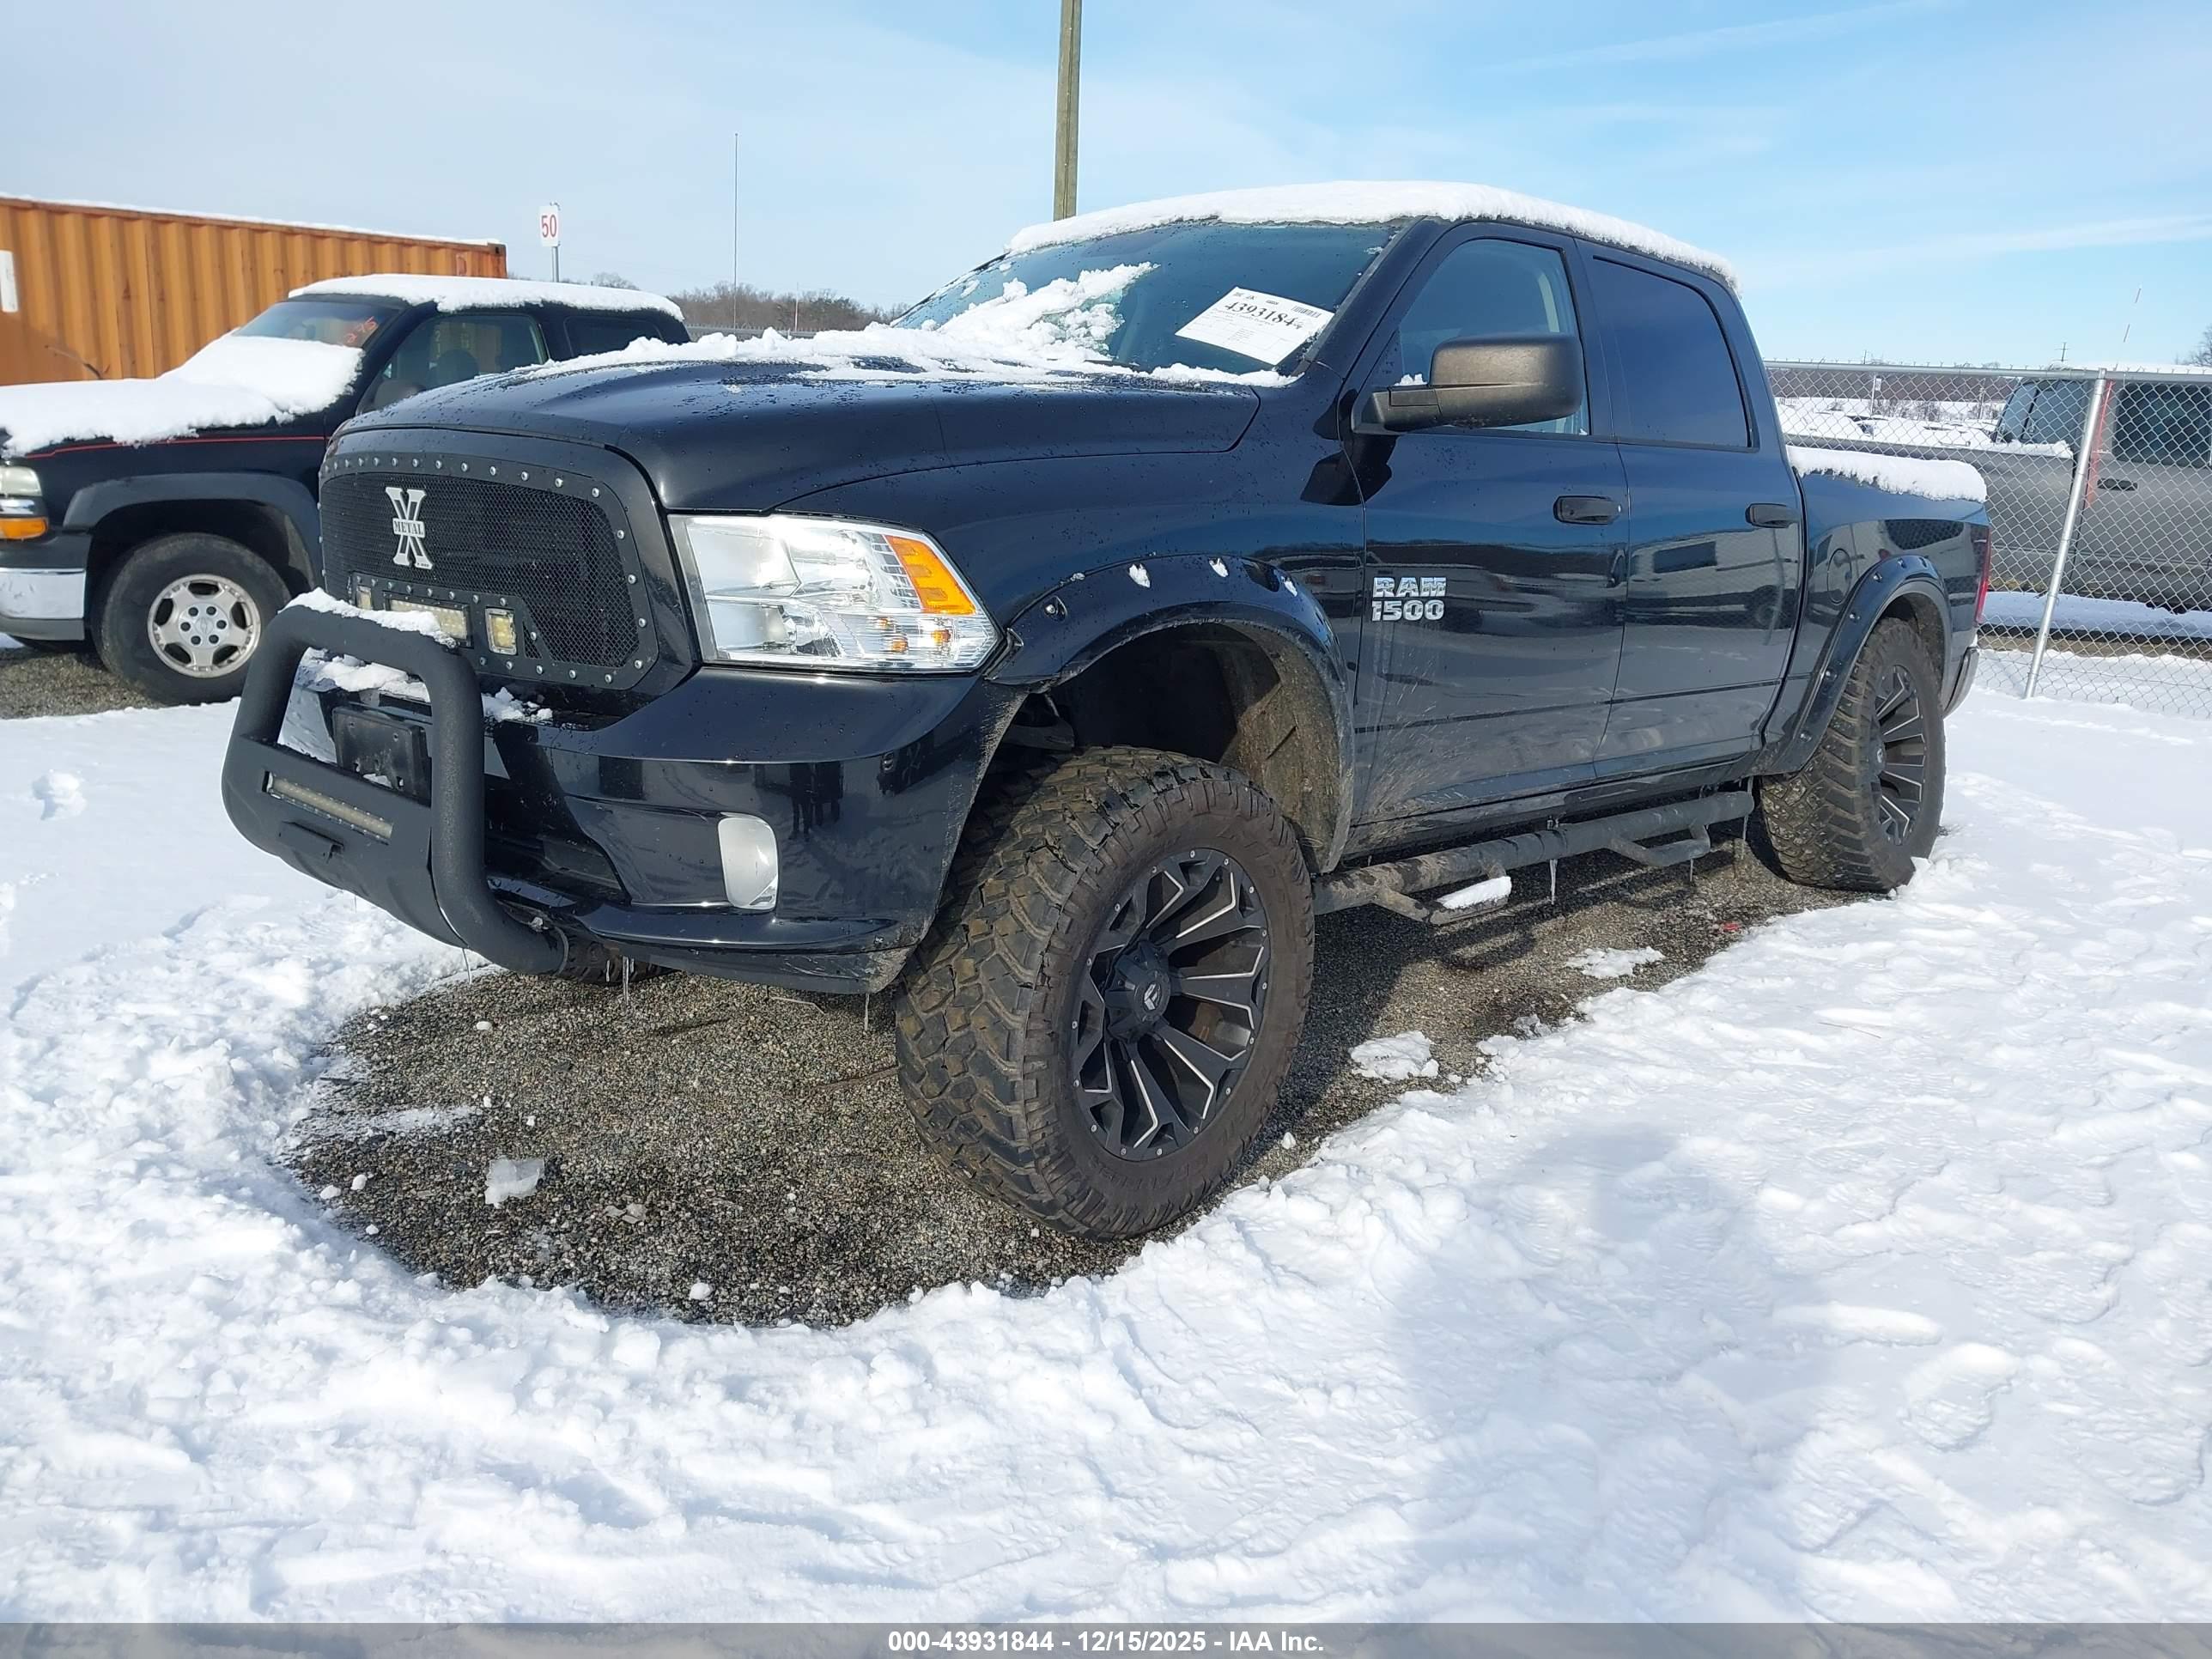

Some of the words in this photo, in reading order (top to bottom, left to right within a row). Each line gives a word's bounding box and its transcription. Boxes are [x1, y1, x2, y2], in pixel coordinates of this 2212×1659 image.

[541, 214, 557, 238] 50
[393, 520, 424, 535] METAL
[1372, 577, 1447, 598] RAM
[1371, 599, 1444, 622] 1500
